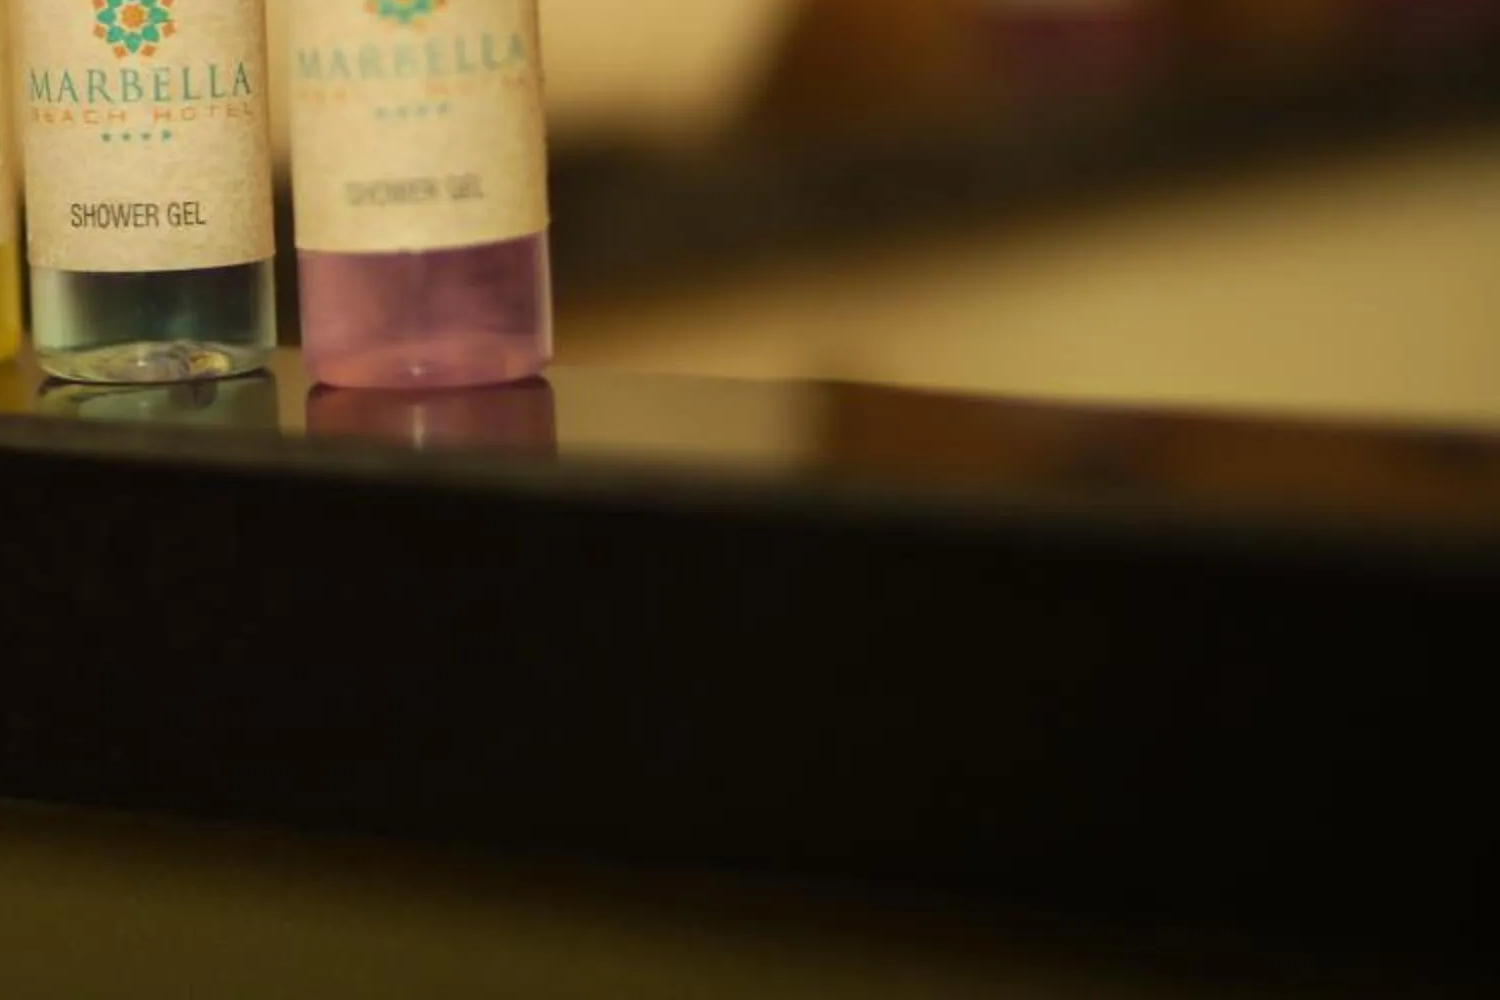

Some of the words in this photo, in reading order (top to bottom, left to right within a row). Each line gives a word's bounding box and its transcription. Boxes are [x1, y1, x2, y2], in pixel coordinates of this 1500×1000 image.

[30, 62, 252, 103] MARBELLA
[152, 101, 253, 123] HOTEL
[70, 202, 160, 229] SHOWER
[166, 201, 207, 227] GEL
